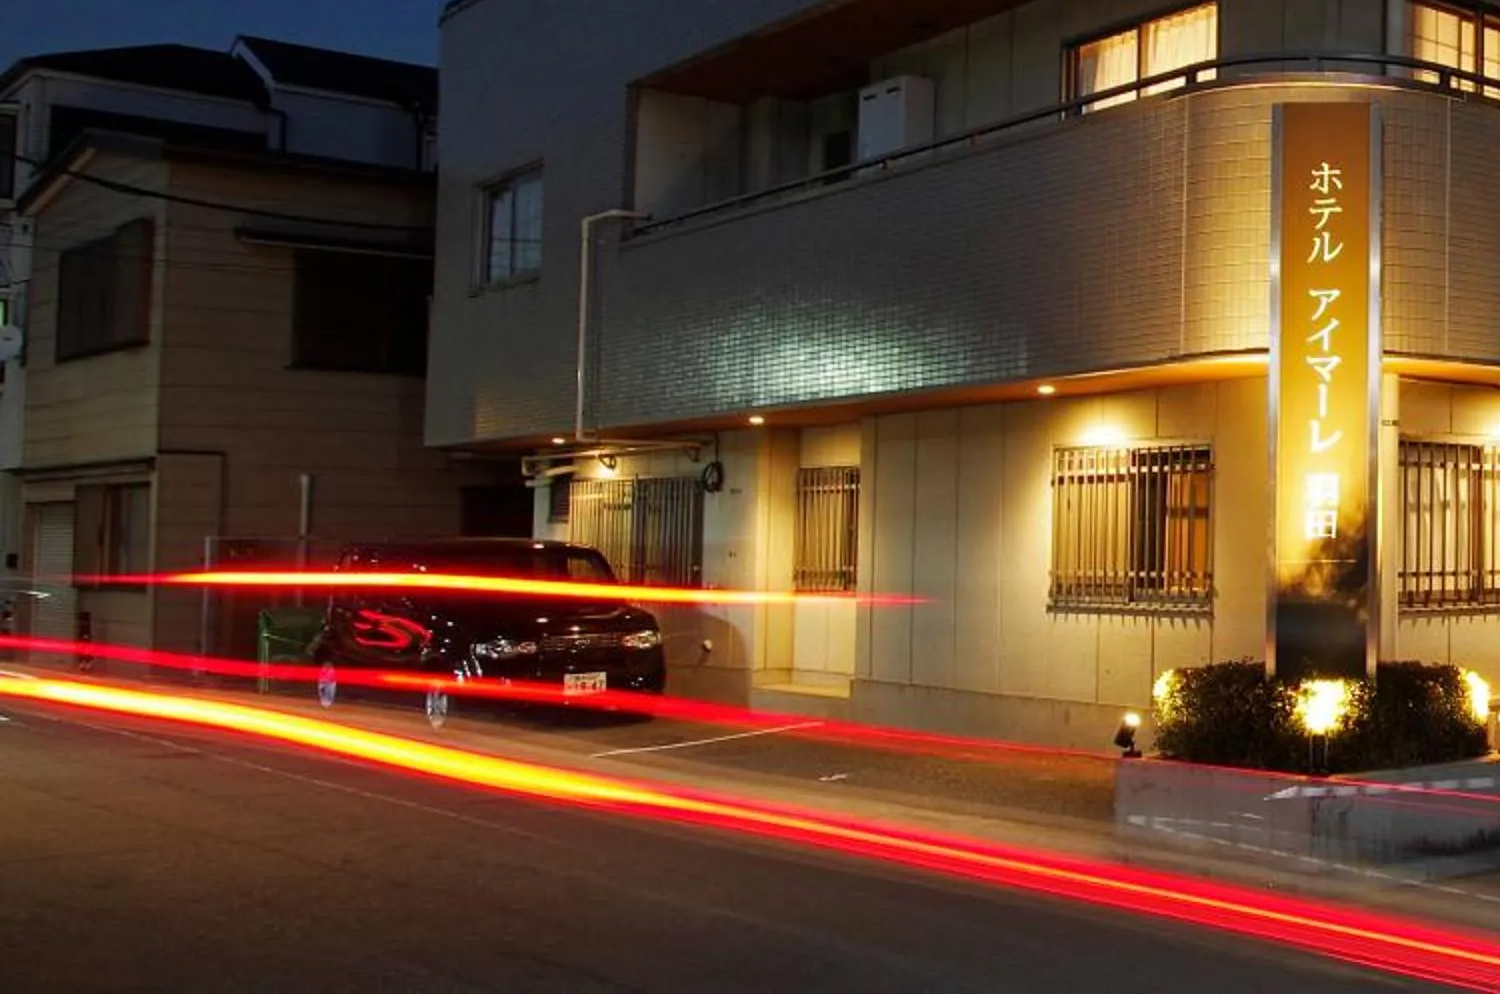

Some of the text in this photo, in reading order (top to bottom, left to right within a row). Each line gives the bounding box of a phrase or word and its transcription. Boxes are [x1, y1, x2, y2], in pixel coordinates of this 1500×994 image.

[1308, 162, 1344, 264] ホテル
[1306, 287, 1343, 453] アイマーレ
